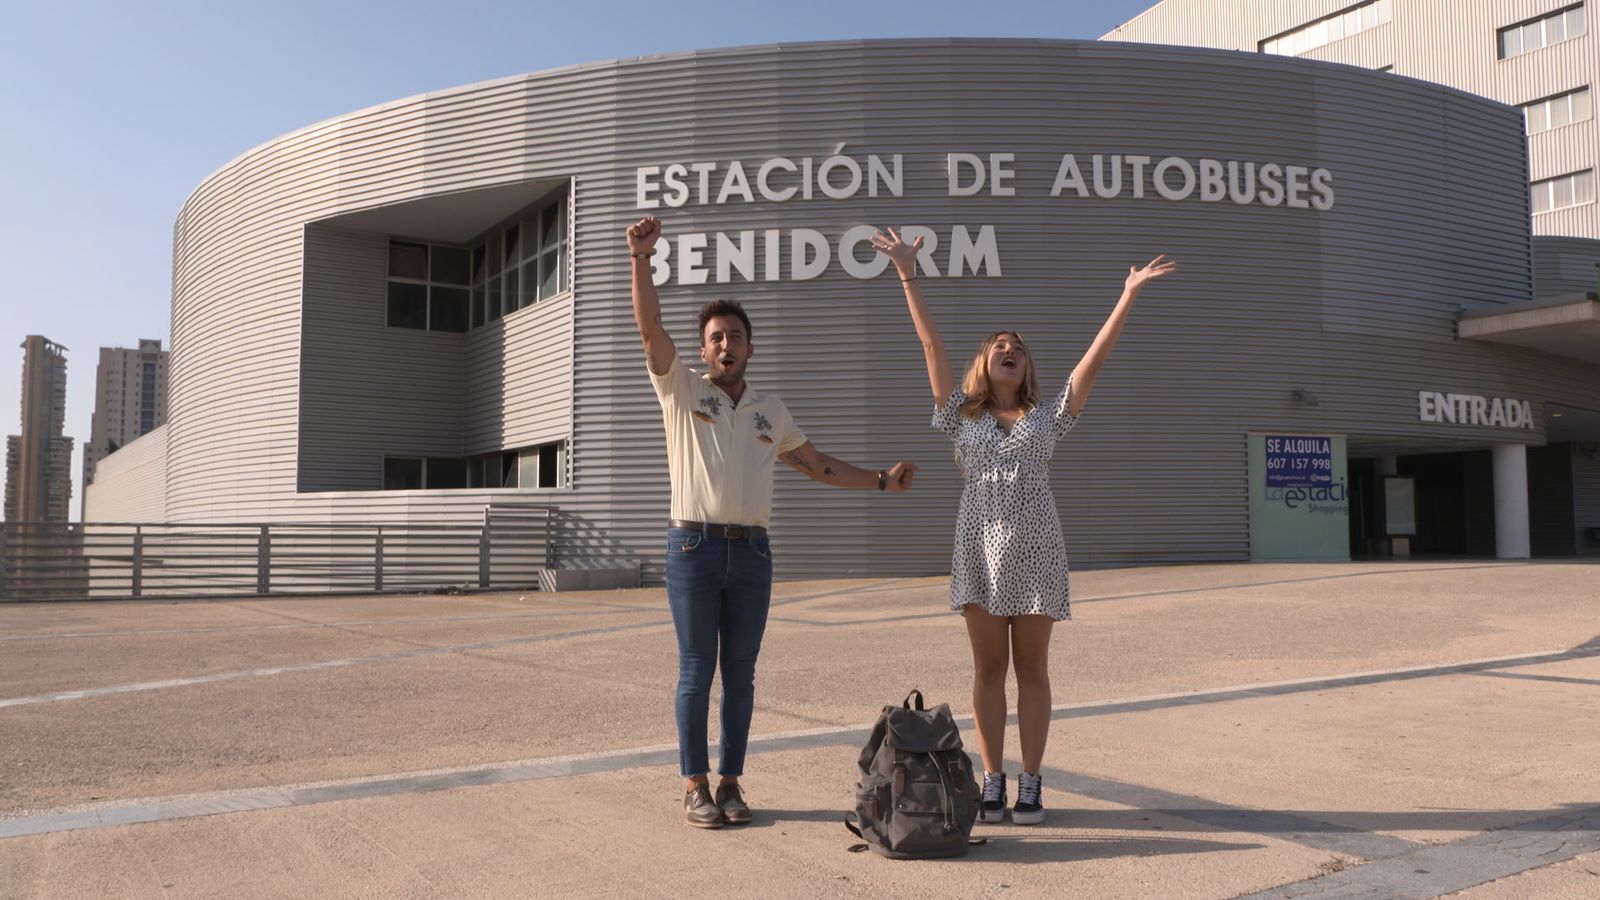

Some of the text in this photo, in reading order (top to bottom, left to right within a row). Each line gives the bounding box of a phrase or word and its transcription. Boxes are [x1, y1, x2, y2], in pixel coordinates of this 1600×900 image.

[636, 142, 1335, 212] ESTACIÓN DE AUTOBUSES
[1418, 390, 1535, 430] ENTRADA
[1267, 439, 1330, 454] SE ALQUILA
[1267, 458, 1331, 470] 607 157 998
[1285, 476, 1349, 508] estaci
